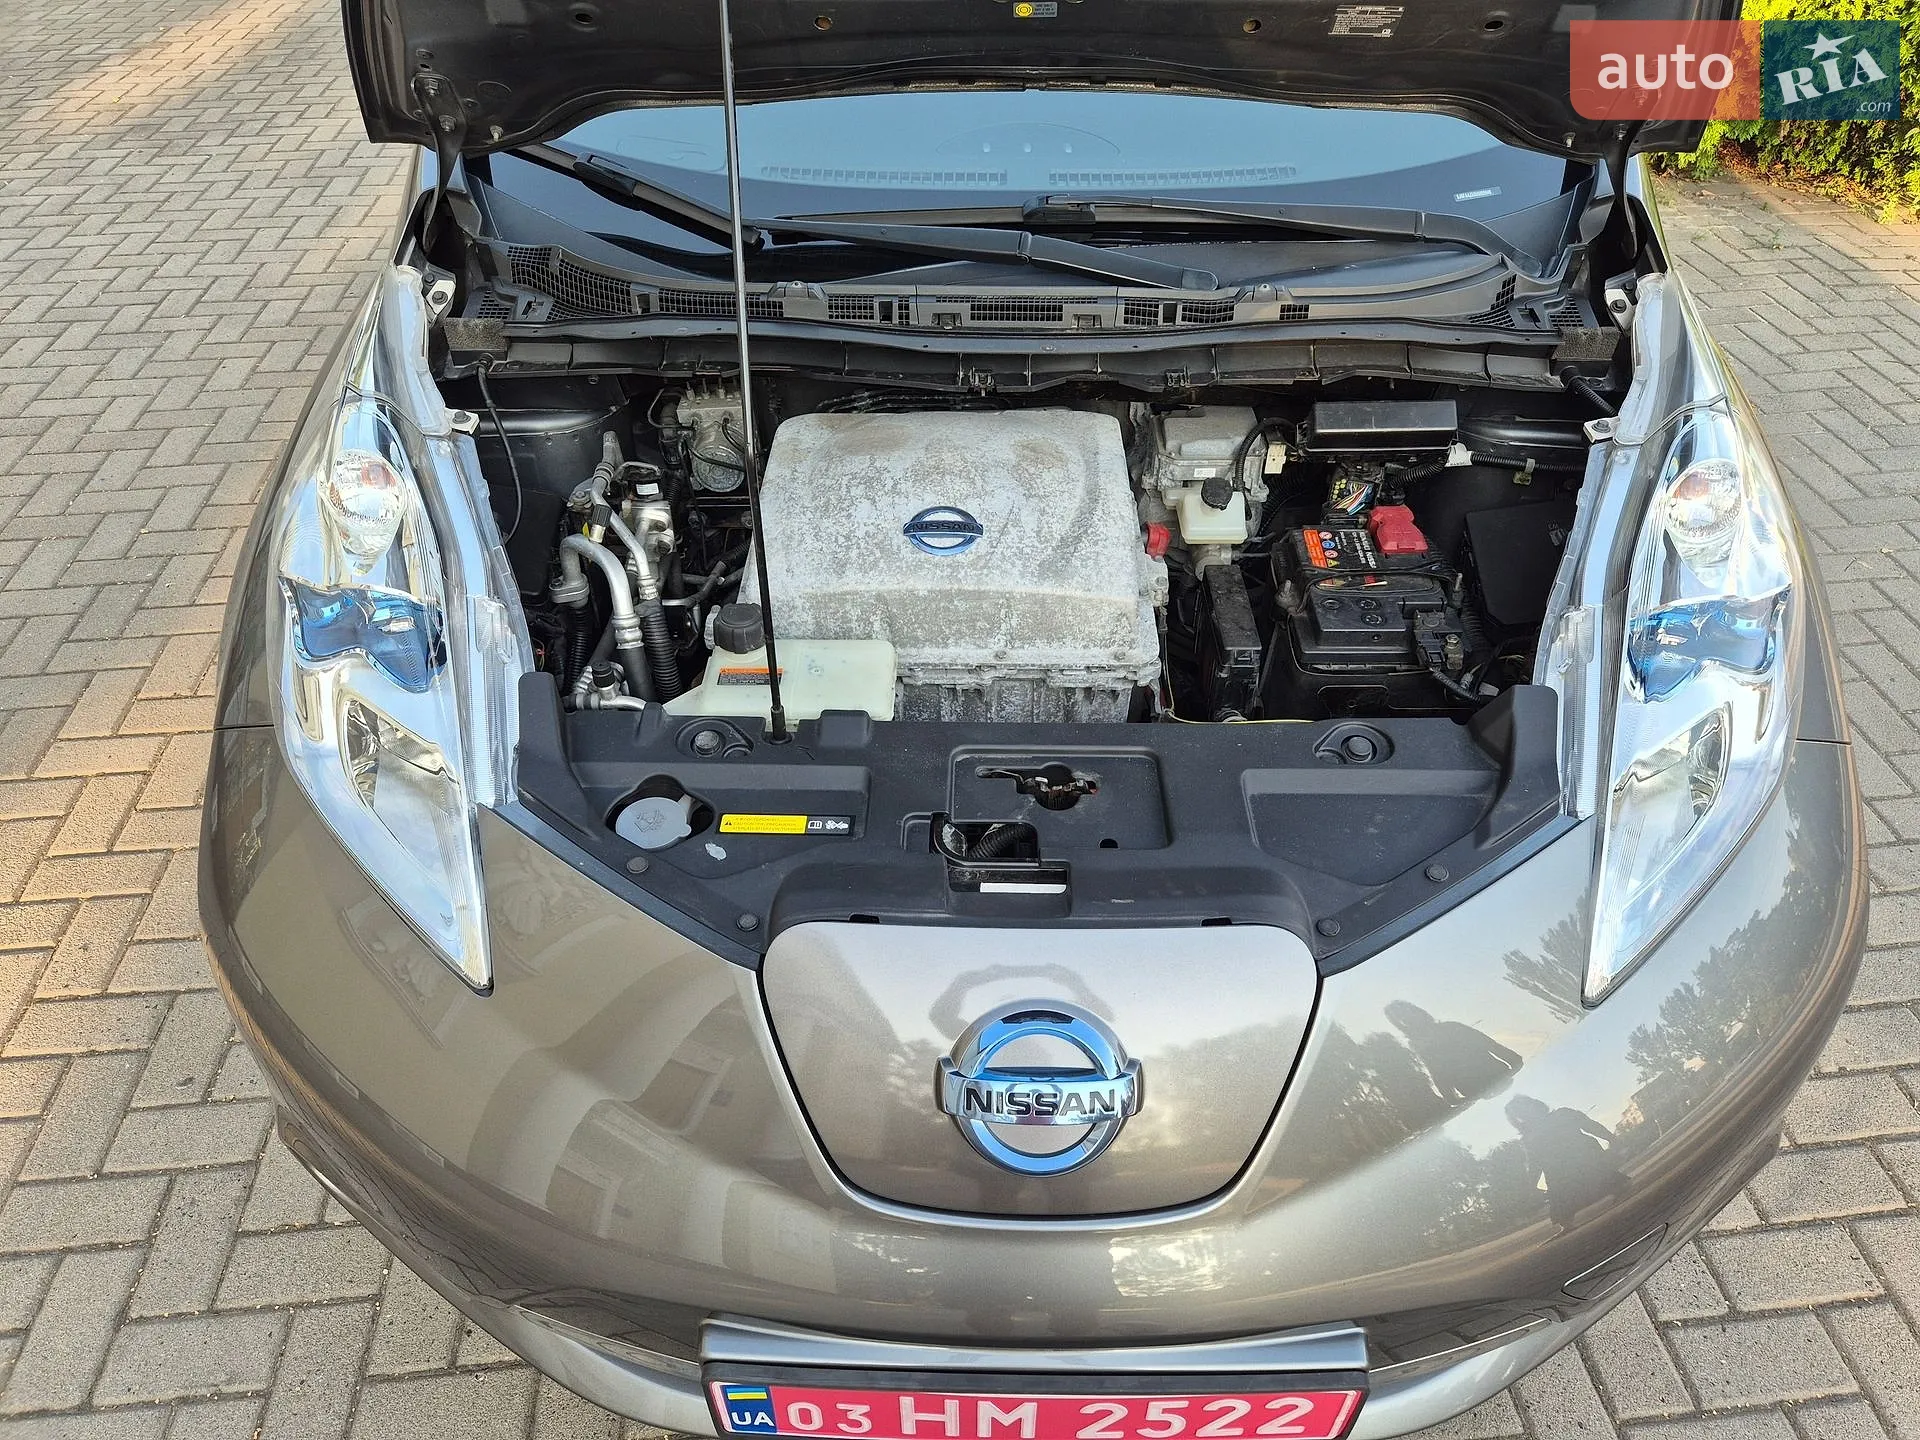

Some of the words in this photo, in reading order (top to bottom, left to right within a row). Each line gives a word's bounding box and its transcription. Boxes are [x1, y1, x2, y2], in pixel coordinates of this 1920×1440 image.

[912, 522, 976, 532] NISSAN
[965, 1087, 1116, 1117] NISSAN
[731, 1411, 775, 1427] UA
[786, 1401, 873, 1434] 03
[899, 1396, 1038, 1439] HM
[1075, 1396, 1315, 1439] 2522
